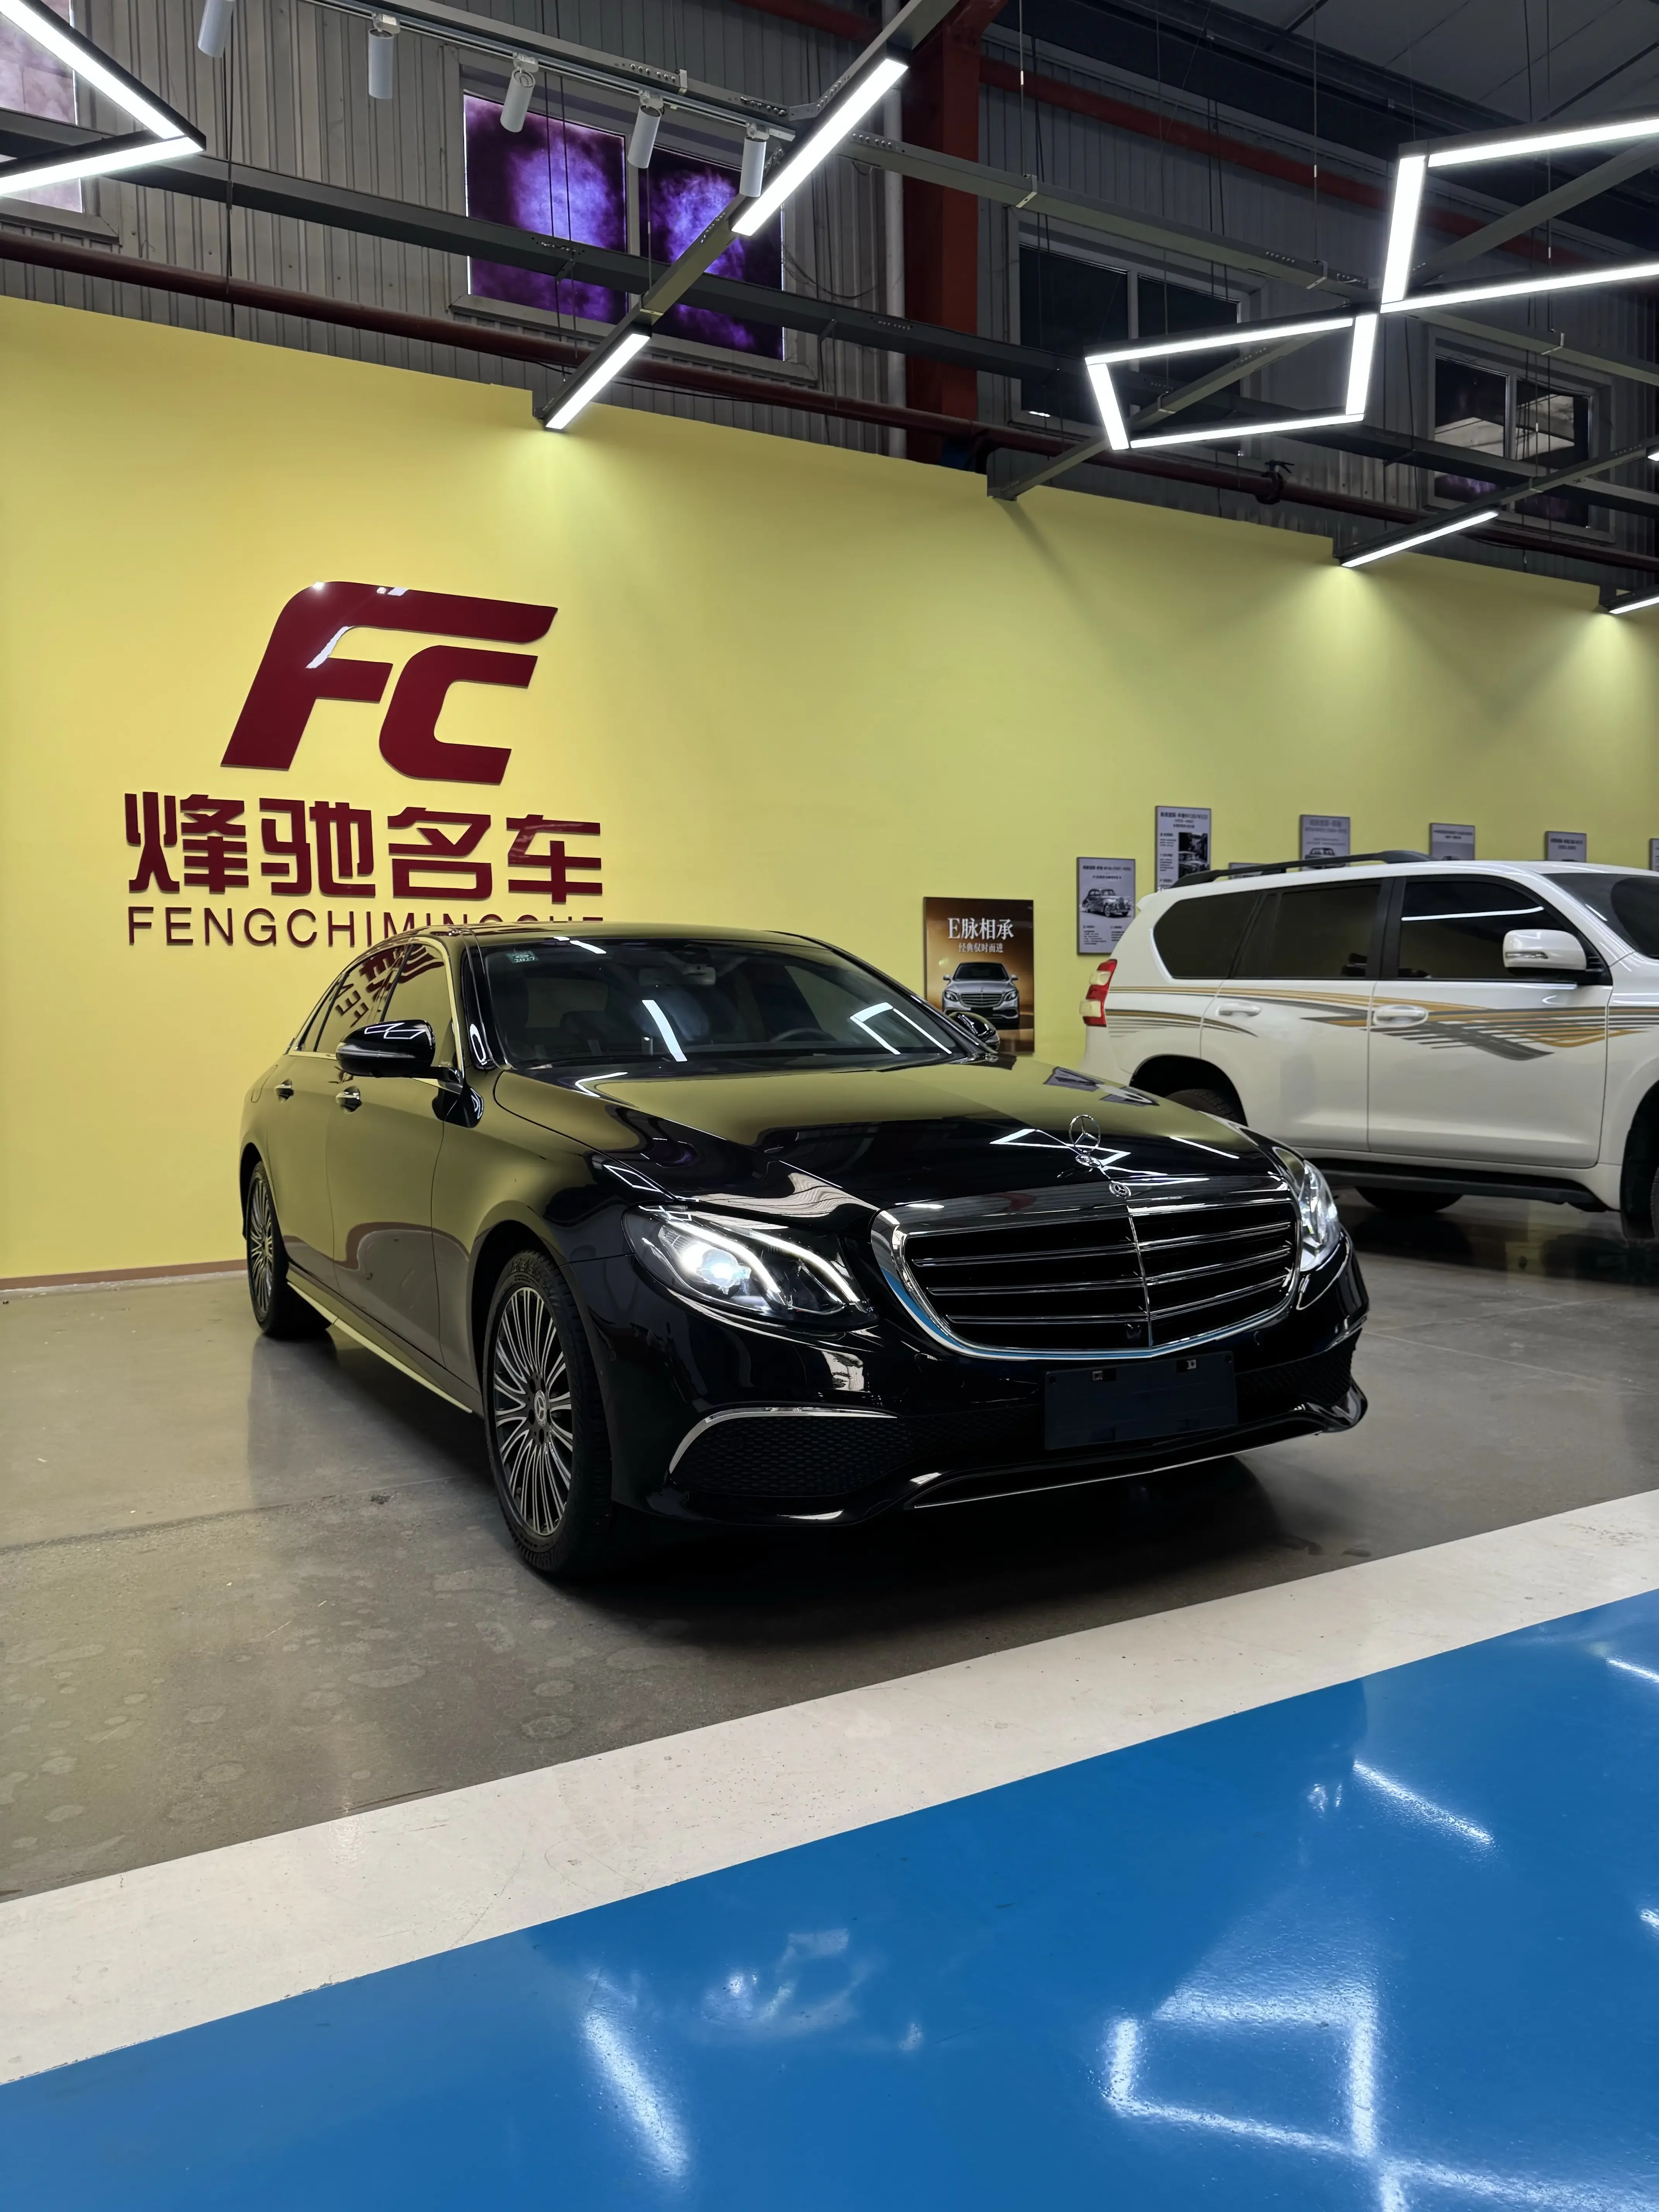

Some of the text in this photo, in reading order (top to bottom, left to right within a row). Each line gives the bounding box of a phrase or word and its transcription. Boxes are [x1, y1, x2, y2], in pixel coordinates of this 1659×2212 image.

[221, 581, 558, 785] FC
[125, 791, 603, 904] 烽驰名车
[128, 907, 603, 947] FENGCHIM
[947, 917, 1014, 940] E脉相承
